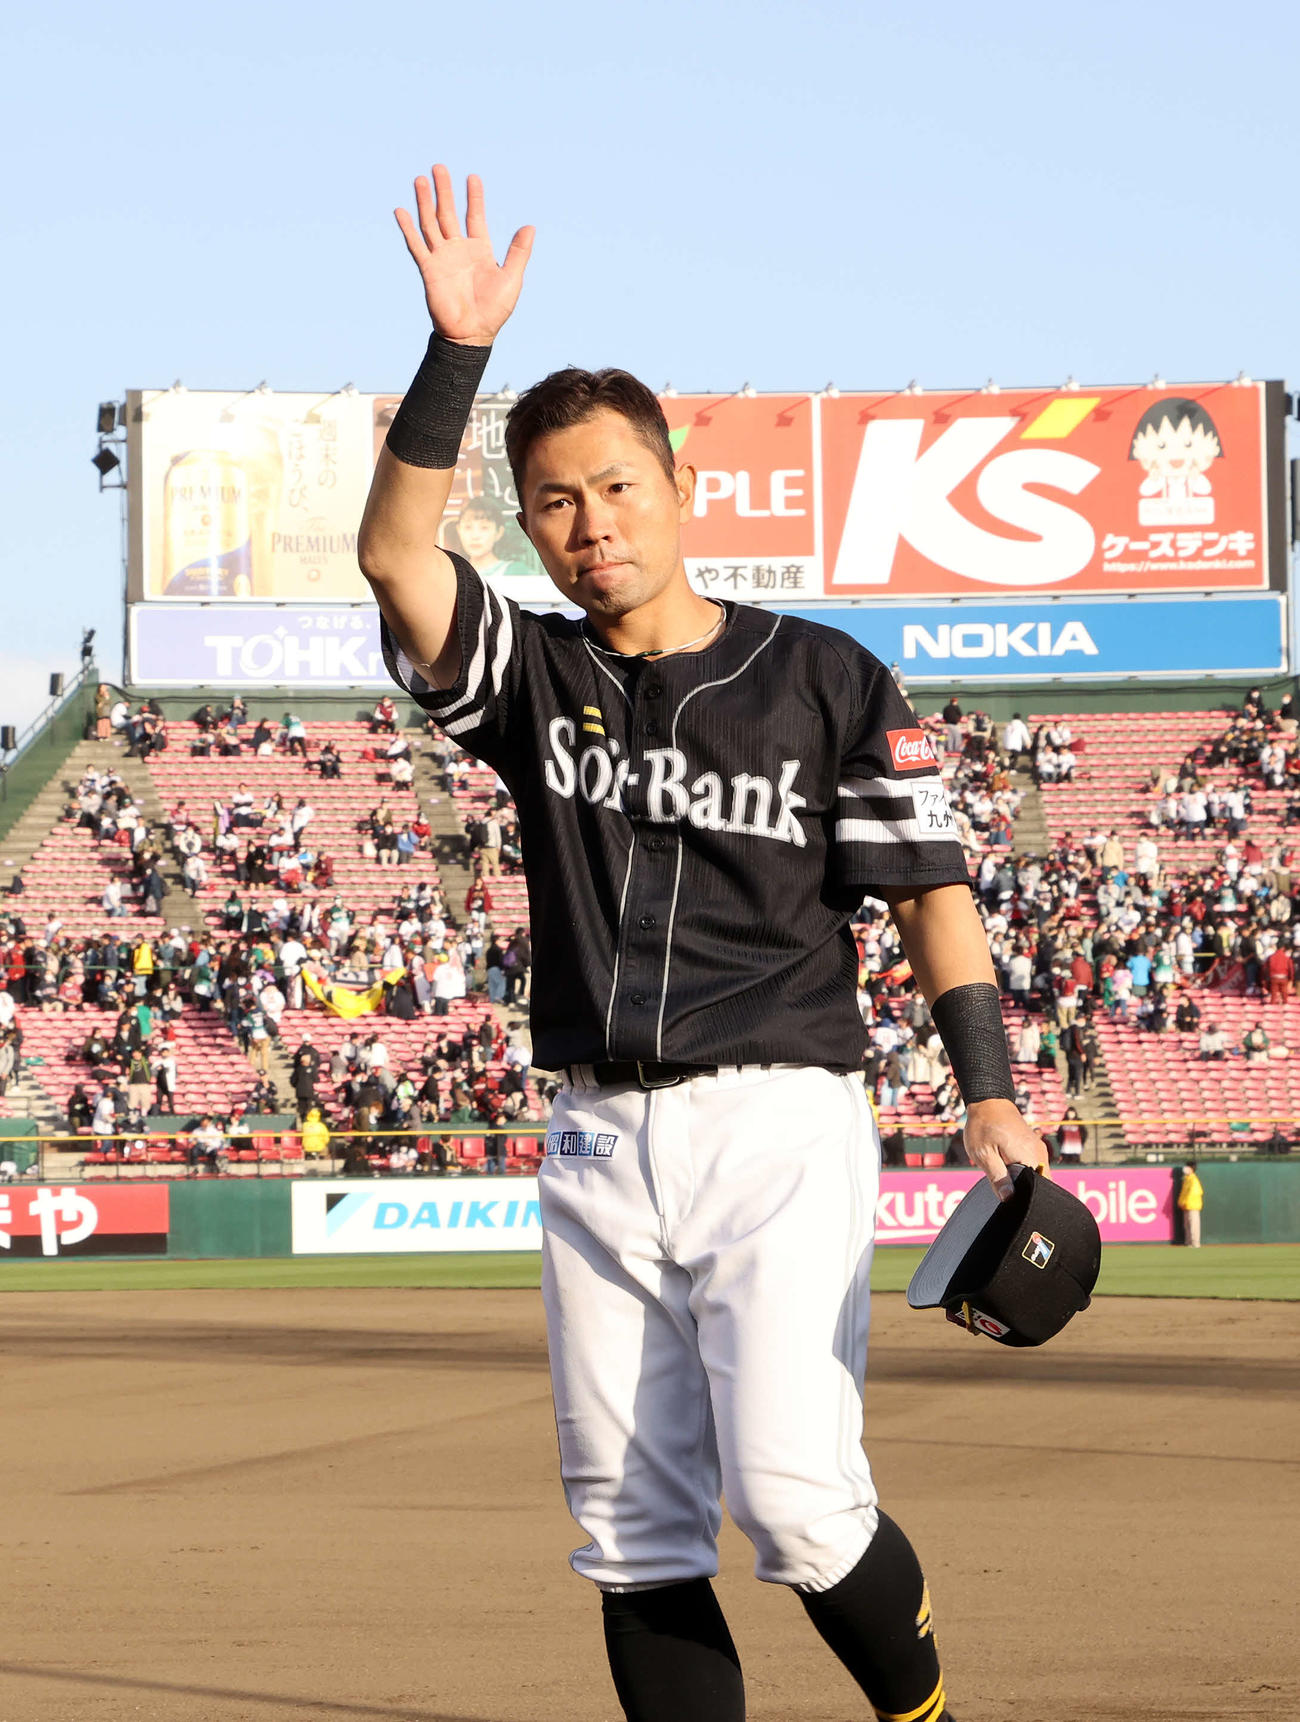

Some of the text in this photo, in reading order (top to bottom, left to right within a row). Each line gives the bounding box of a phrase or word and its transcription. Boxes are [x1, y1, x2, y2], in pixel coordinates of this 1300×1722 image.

[270, 530, 358, 555] PREMIUM
[695, 563, 806, 591] や不動産
[903, 621, 1099, 659] NOKIA
[0, 1187, 98, 1256] や
